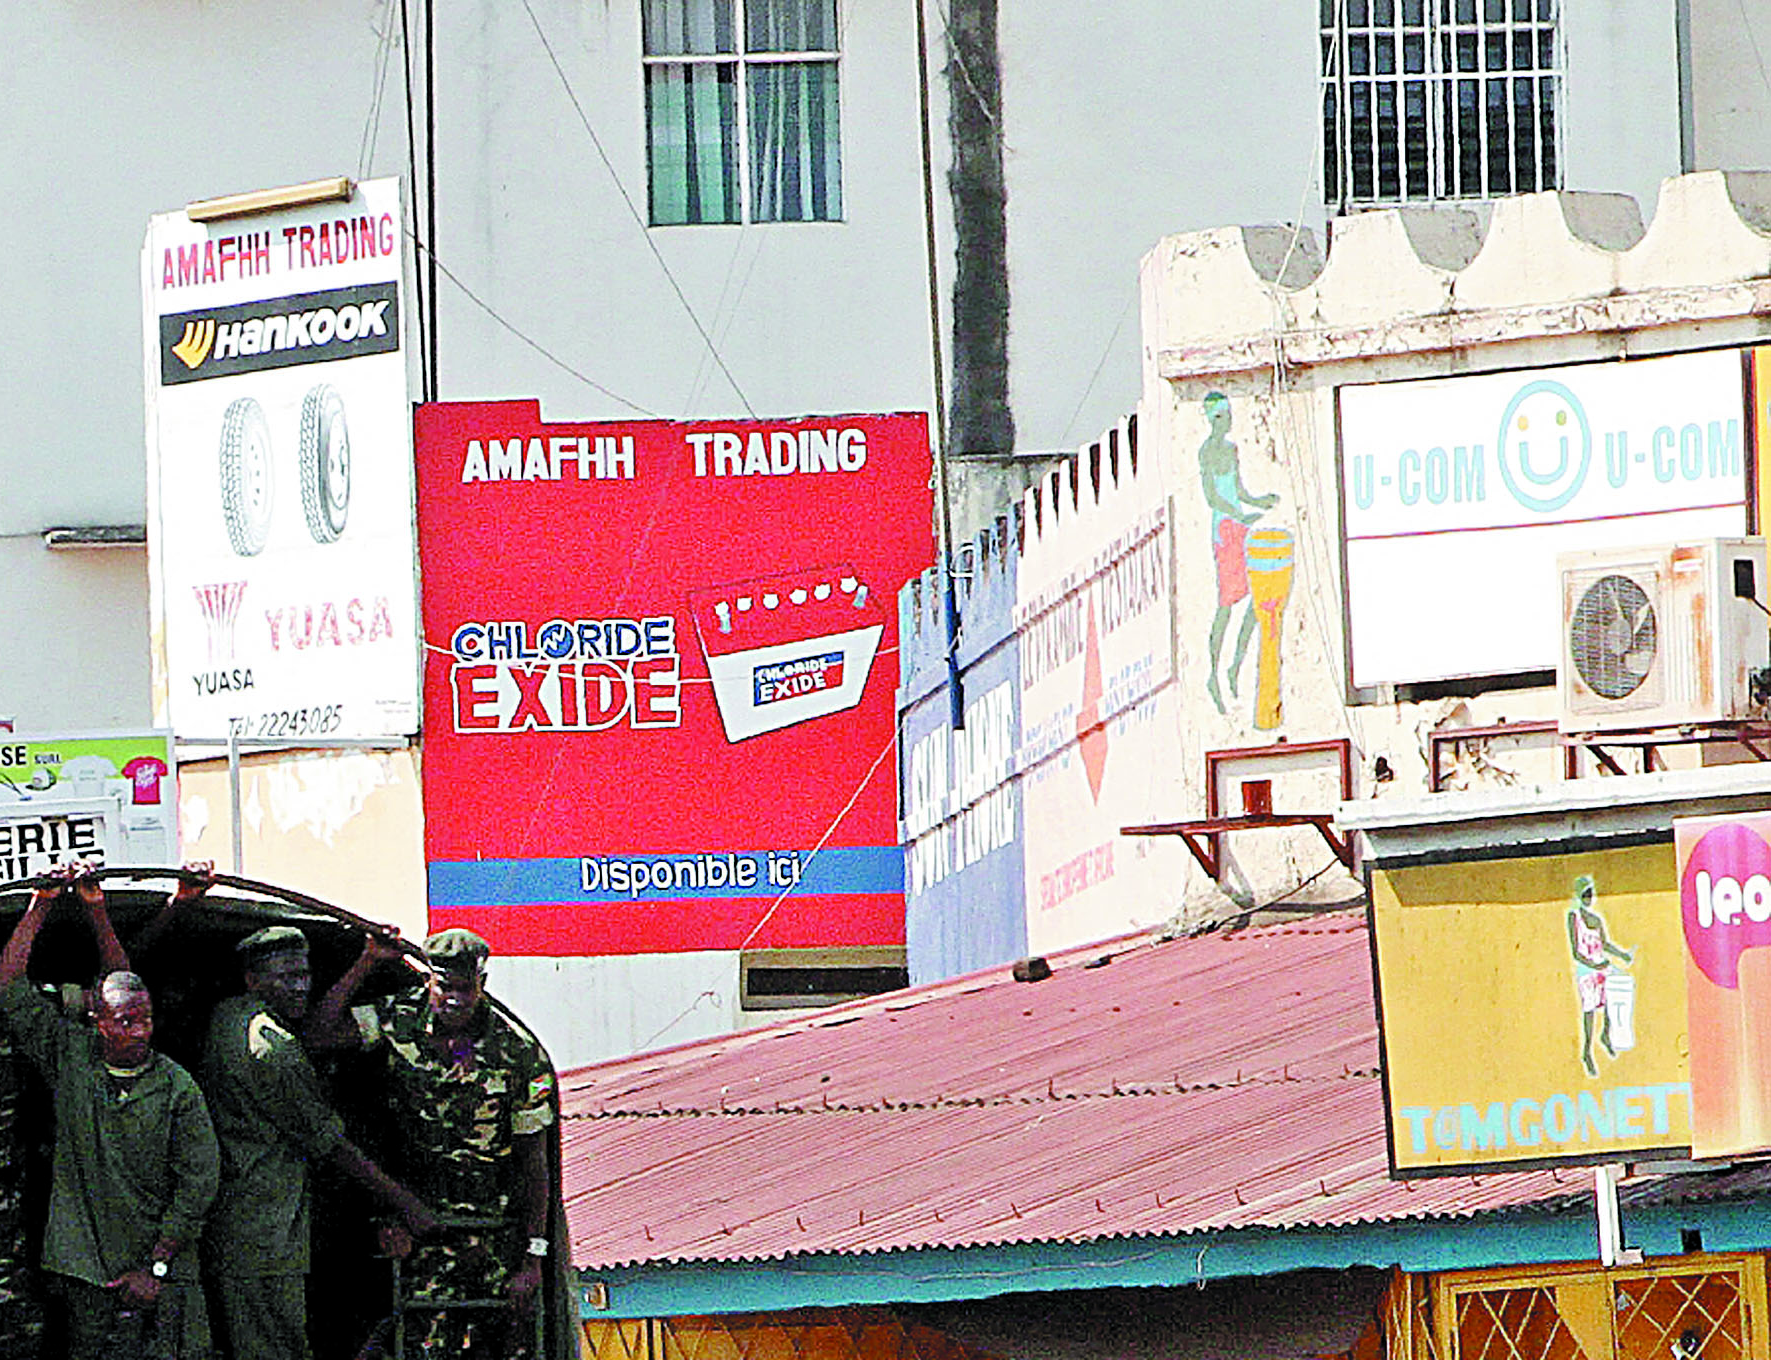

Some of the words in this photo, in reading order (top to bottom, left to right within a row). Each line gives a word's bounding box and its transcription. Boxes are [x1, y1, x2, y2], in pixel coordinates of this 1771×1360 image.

[162, 230, 270, 290] AMAFHH
[282, 212, 394, 270] TRADING
[461, 436, 635, 484] AMAFHH
[686, 428, 868, 478] TRADING
[1354, 445, 1486, 510] U-COM
[1605, 419, 1740, 489] U-COM
[265, 597, 393, 651] YUASA
[452, 618, 675, 662] CHLORIDE
[192, 669, 255, 696] YUASA
[452, 655, 680, 734] EXIDE
[759, 671, 827, 703] EXIDE
[580, 854, 757, 897] Disponible
[768, 851, 801, 886] ici
